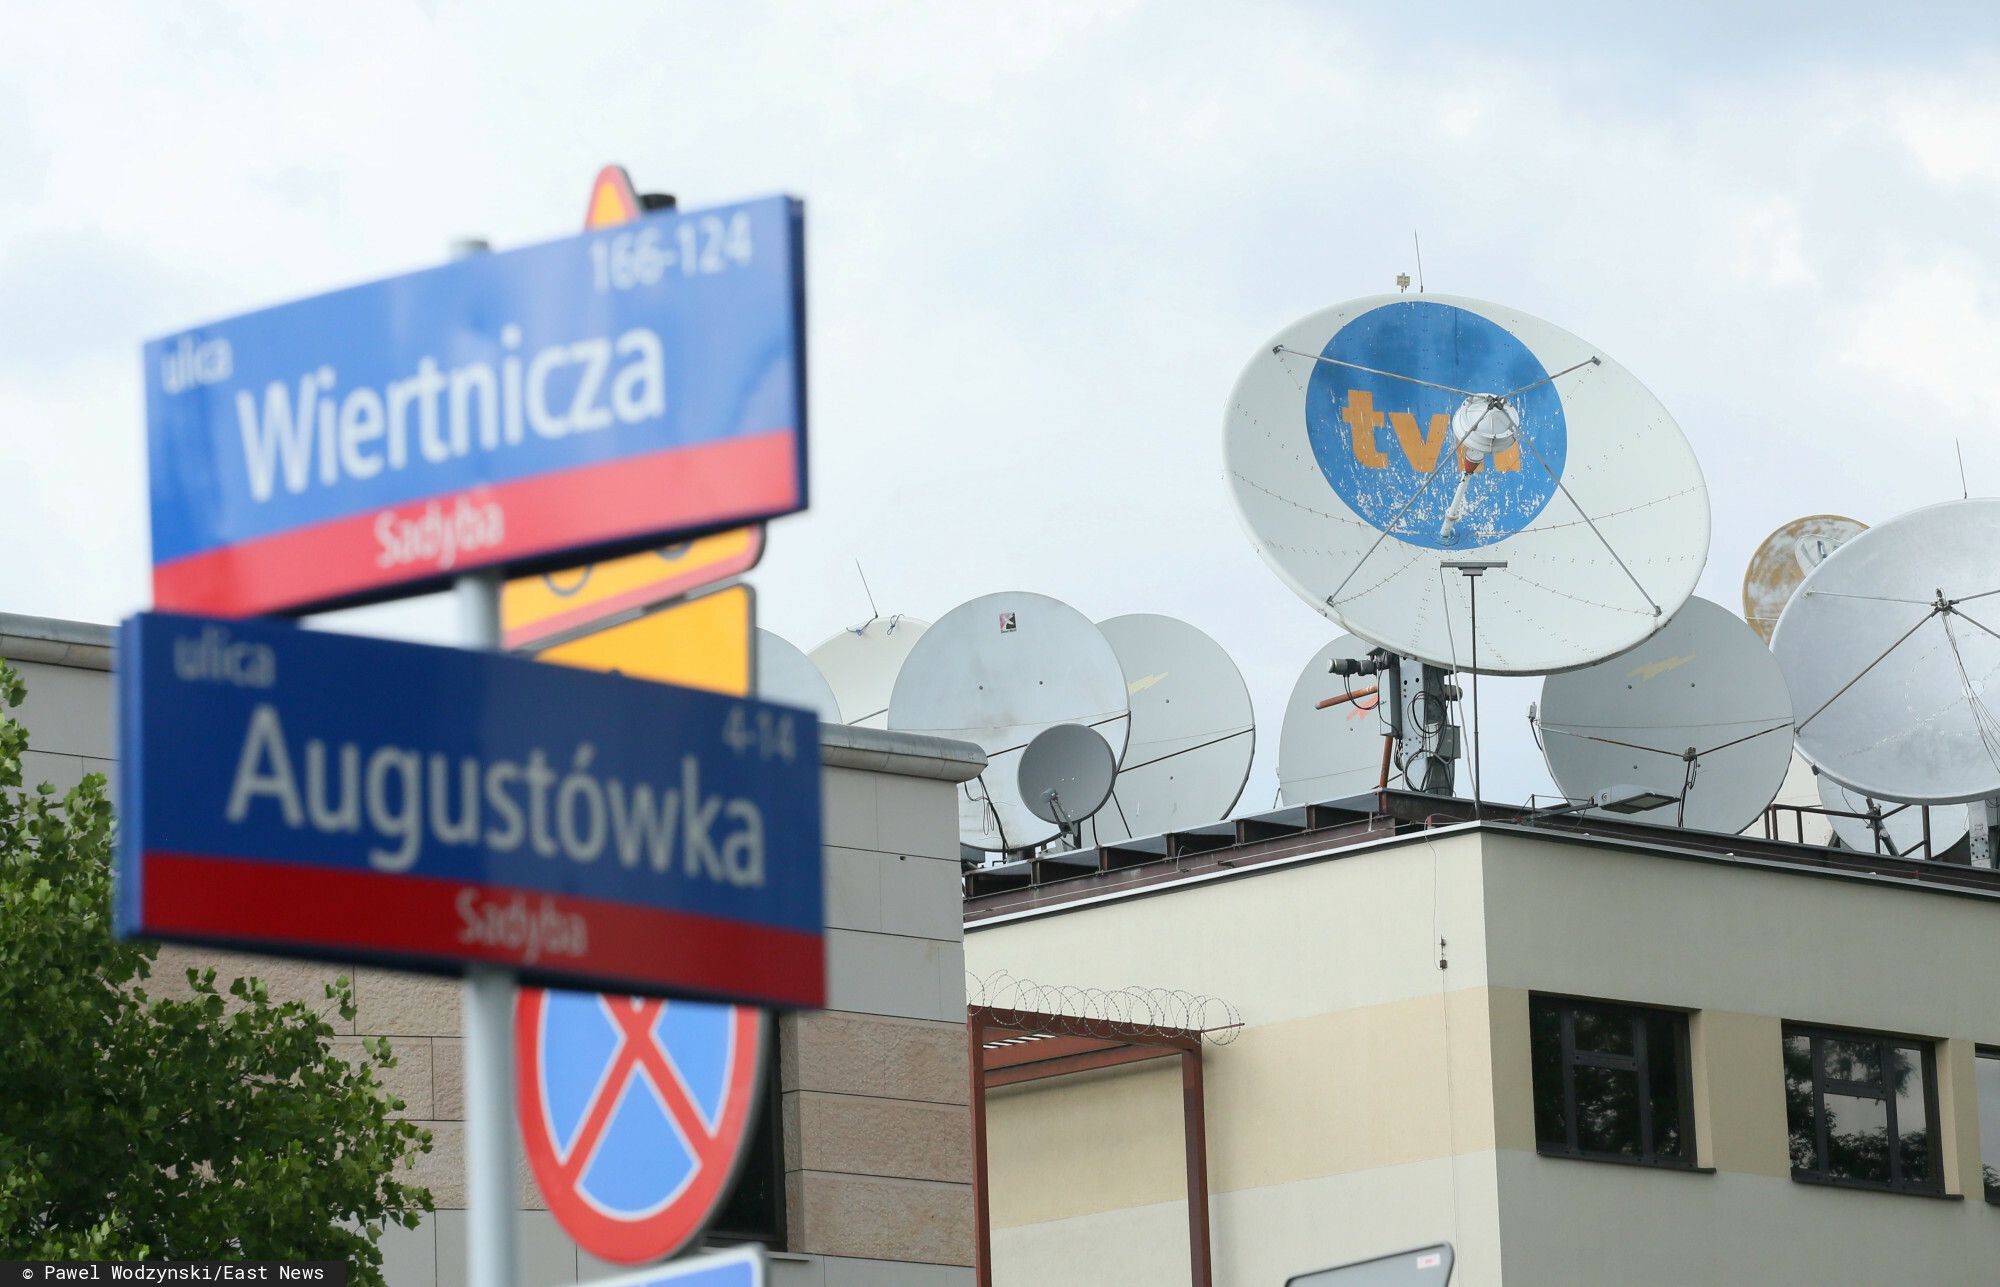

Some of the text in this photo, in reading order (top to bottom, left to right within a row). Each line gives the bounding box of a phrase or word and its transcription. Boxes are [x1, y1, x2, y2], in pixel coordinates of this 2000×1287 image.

[590, 212, 752, 292] 166-124
[161, 336, 232, 393] ulica
[237, 325, 665, 502] Wiertnicza
[375, 486, 504, 567] Sadyba
[174, 627, 276, 688] ulica
[722, 705, 796, 763] 4-14
[227, 705, 766, 887] Augustówka
[456, 889, 588, 962] Sadyba
